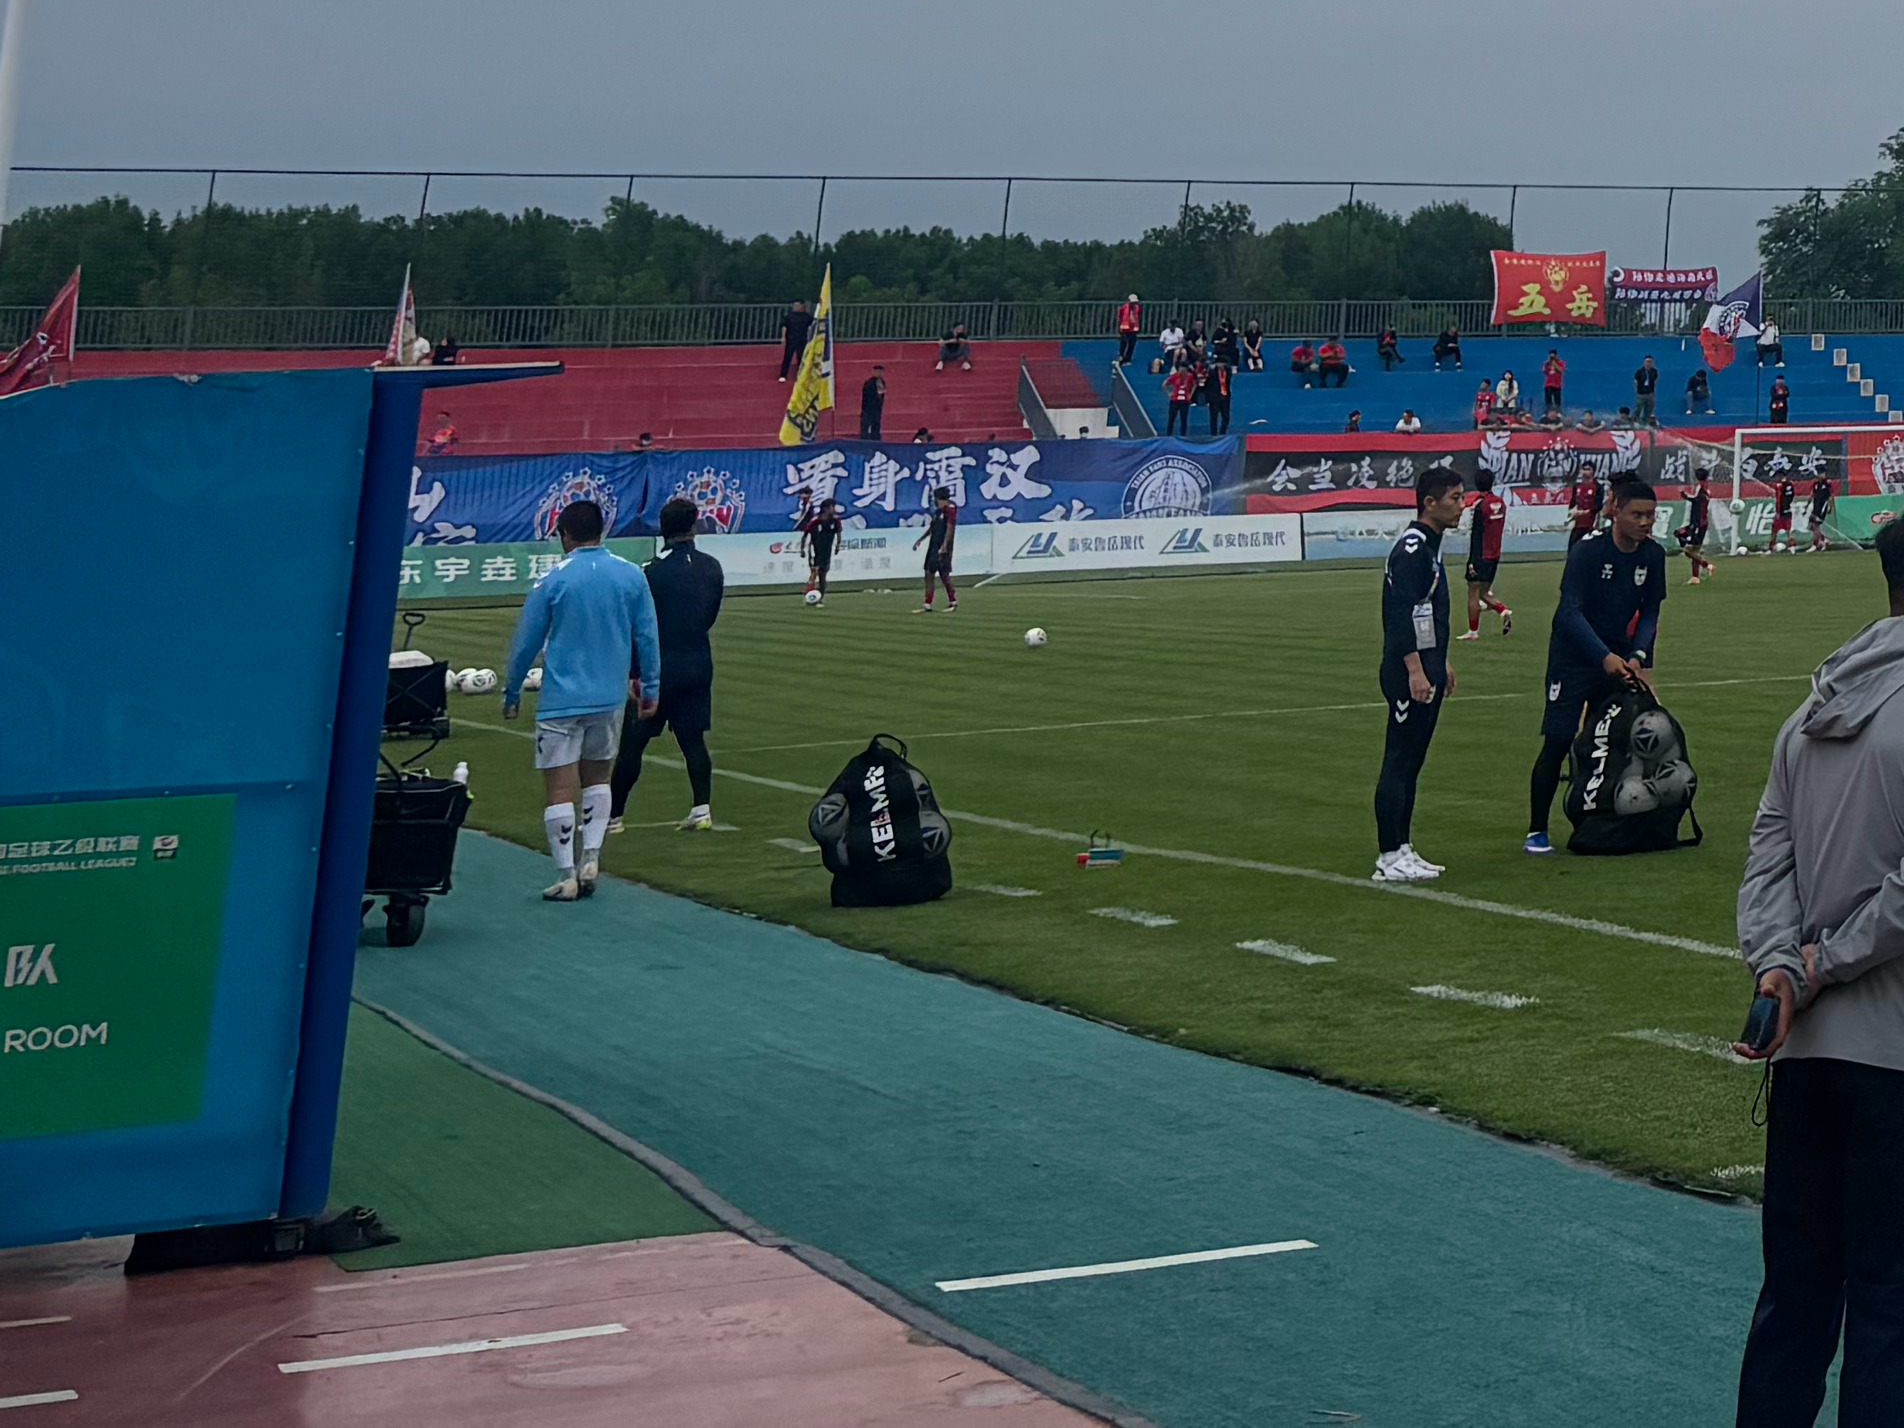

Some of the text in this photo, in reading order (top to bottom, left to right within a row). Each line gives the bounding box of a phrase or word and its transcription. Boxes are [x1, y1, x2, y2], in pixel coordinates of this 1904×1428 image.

[1584, 718, 1611, 810] KELME
[4, 943, 59, 987] 队
[4, 1022, 109, 1053] ROOM
